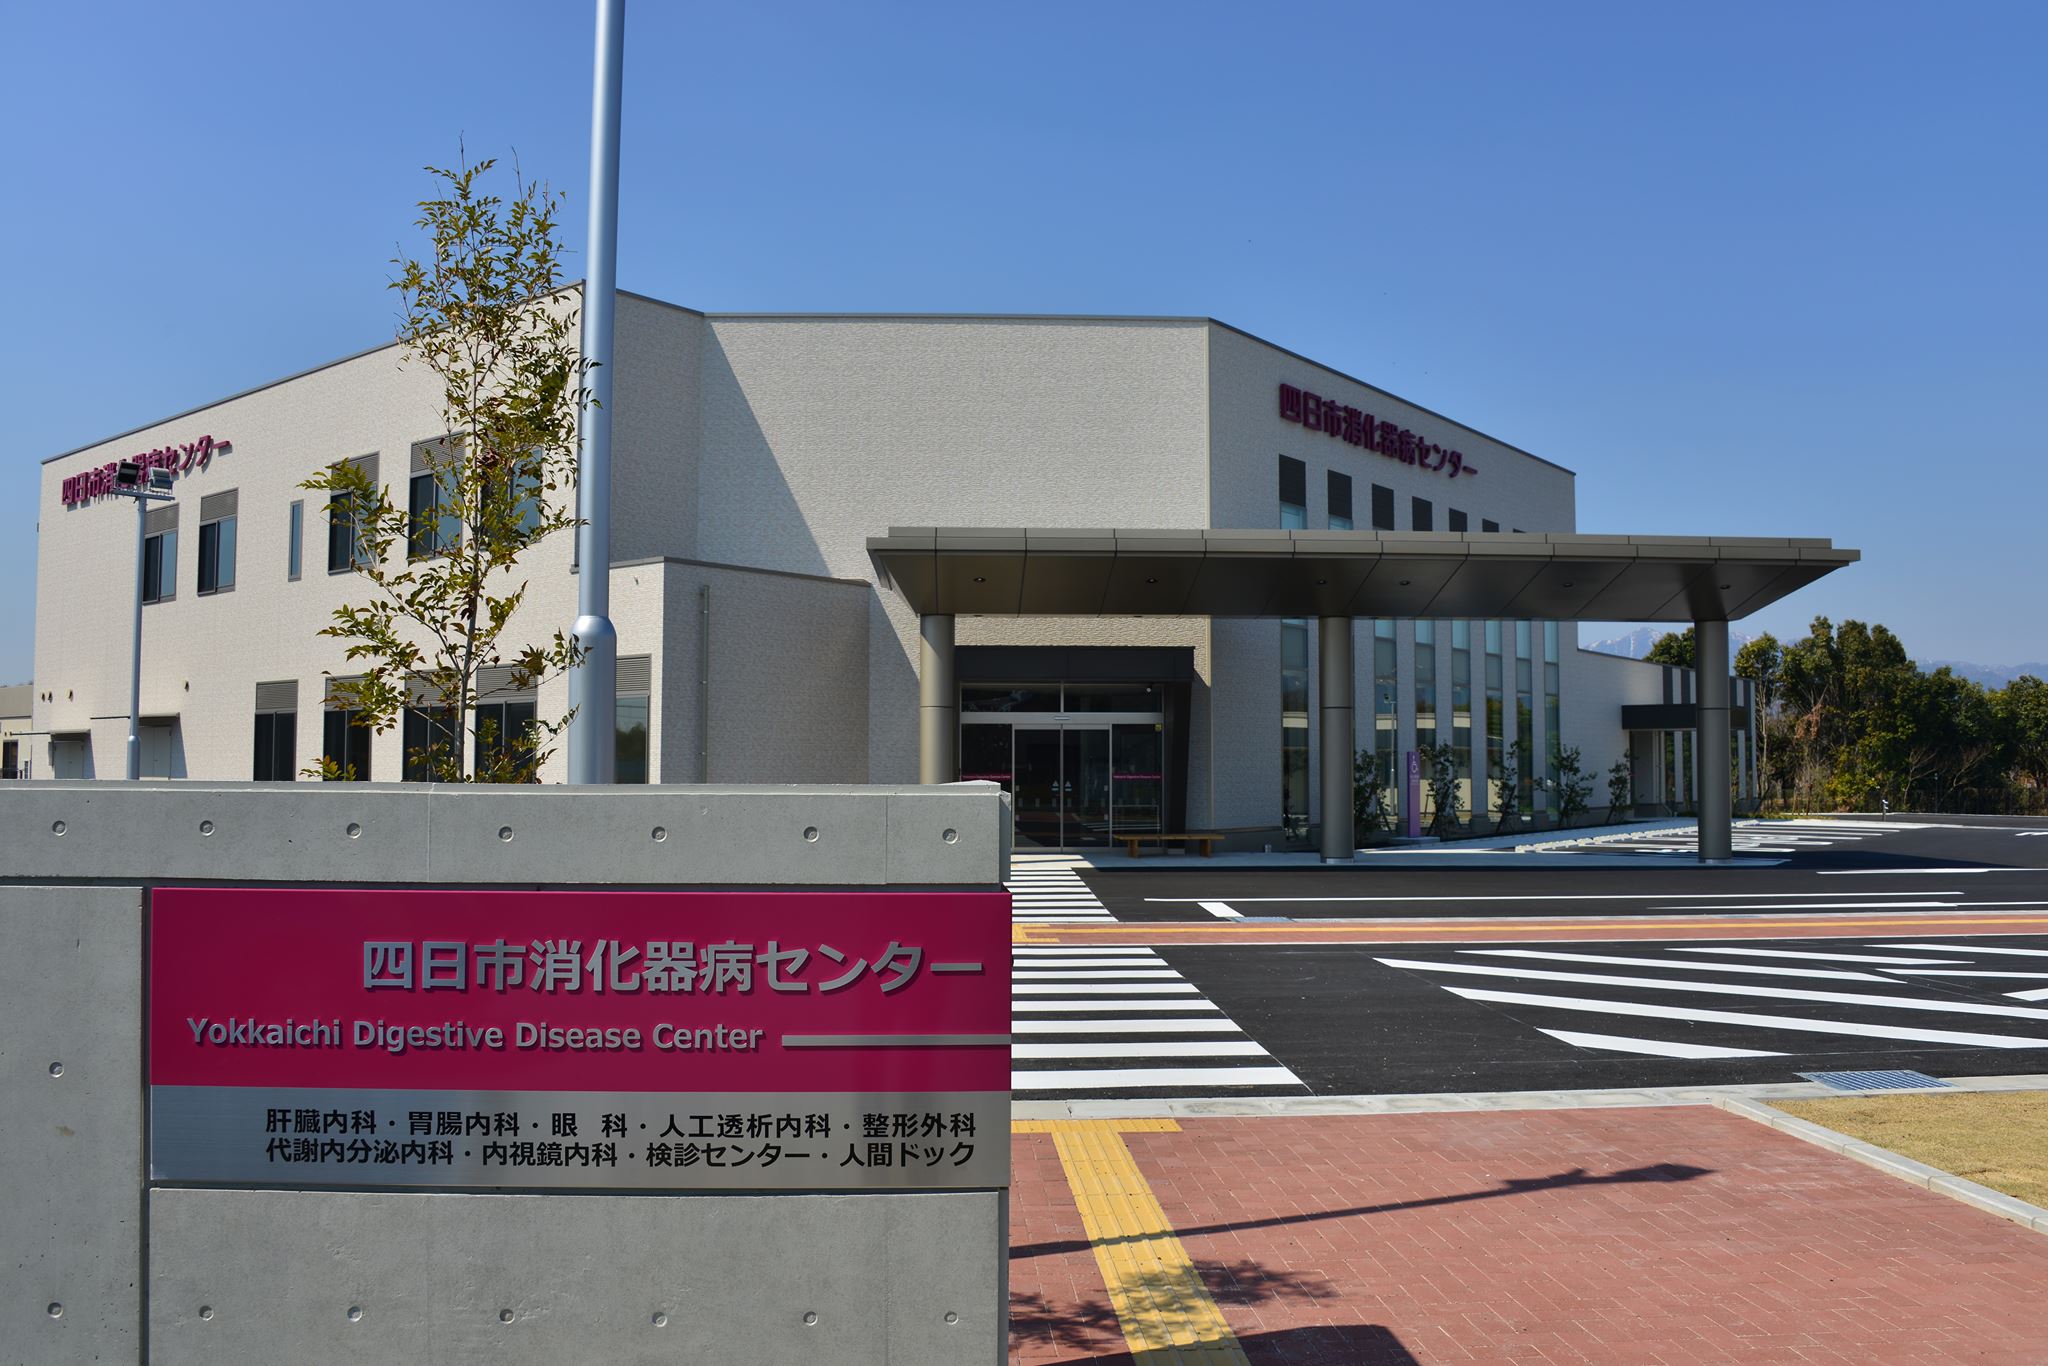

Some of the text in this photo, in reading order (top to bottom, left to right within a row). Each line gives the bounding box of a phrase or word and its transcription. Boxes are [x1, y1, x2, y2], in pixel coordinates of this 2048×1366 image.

[1279, 383, 1478, 478] 四日市消化器病センター
[61, 434, 231, 505] 四日市消器病センター
[363, 939, 983, 994] 四日市消化器病センター
[187, 1017, 763, 1052] Yokkaichi Digestive Disease Center
